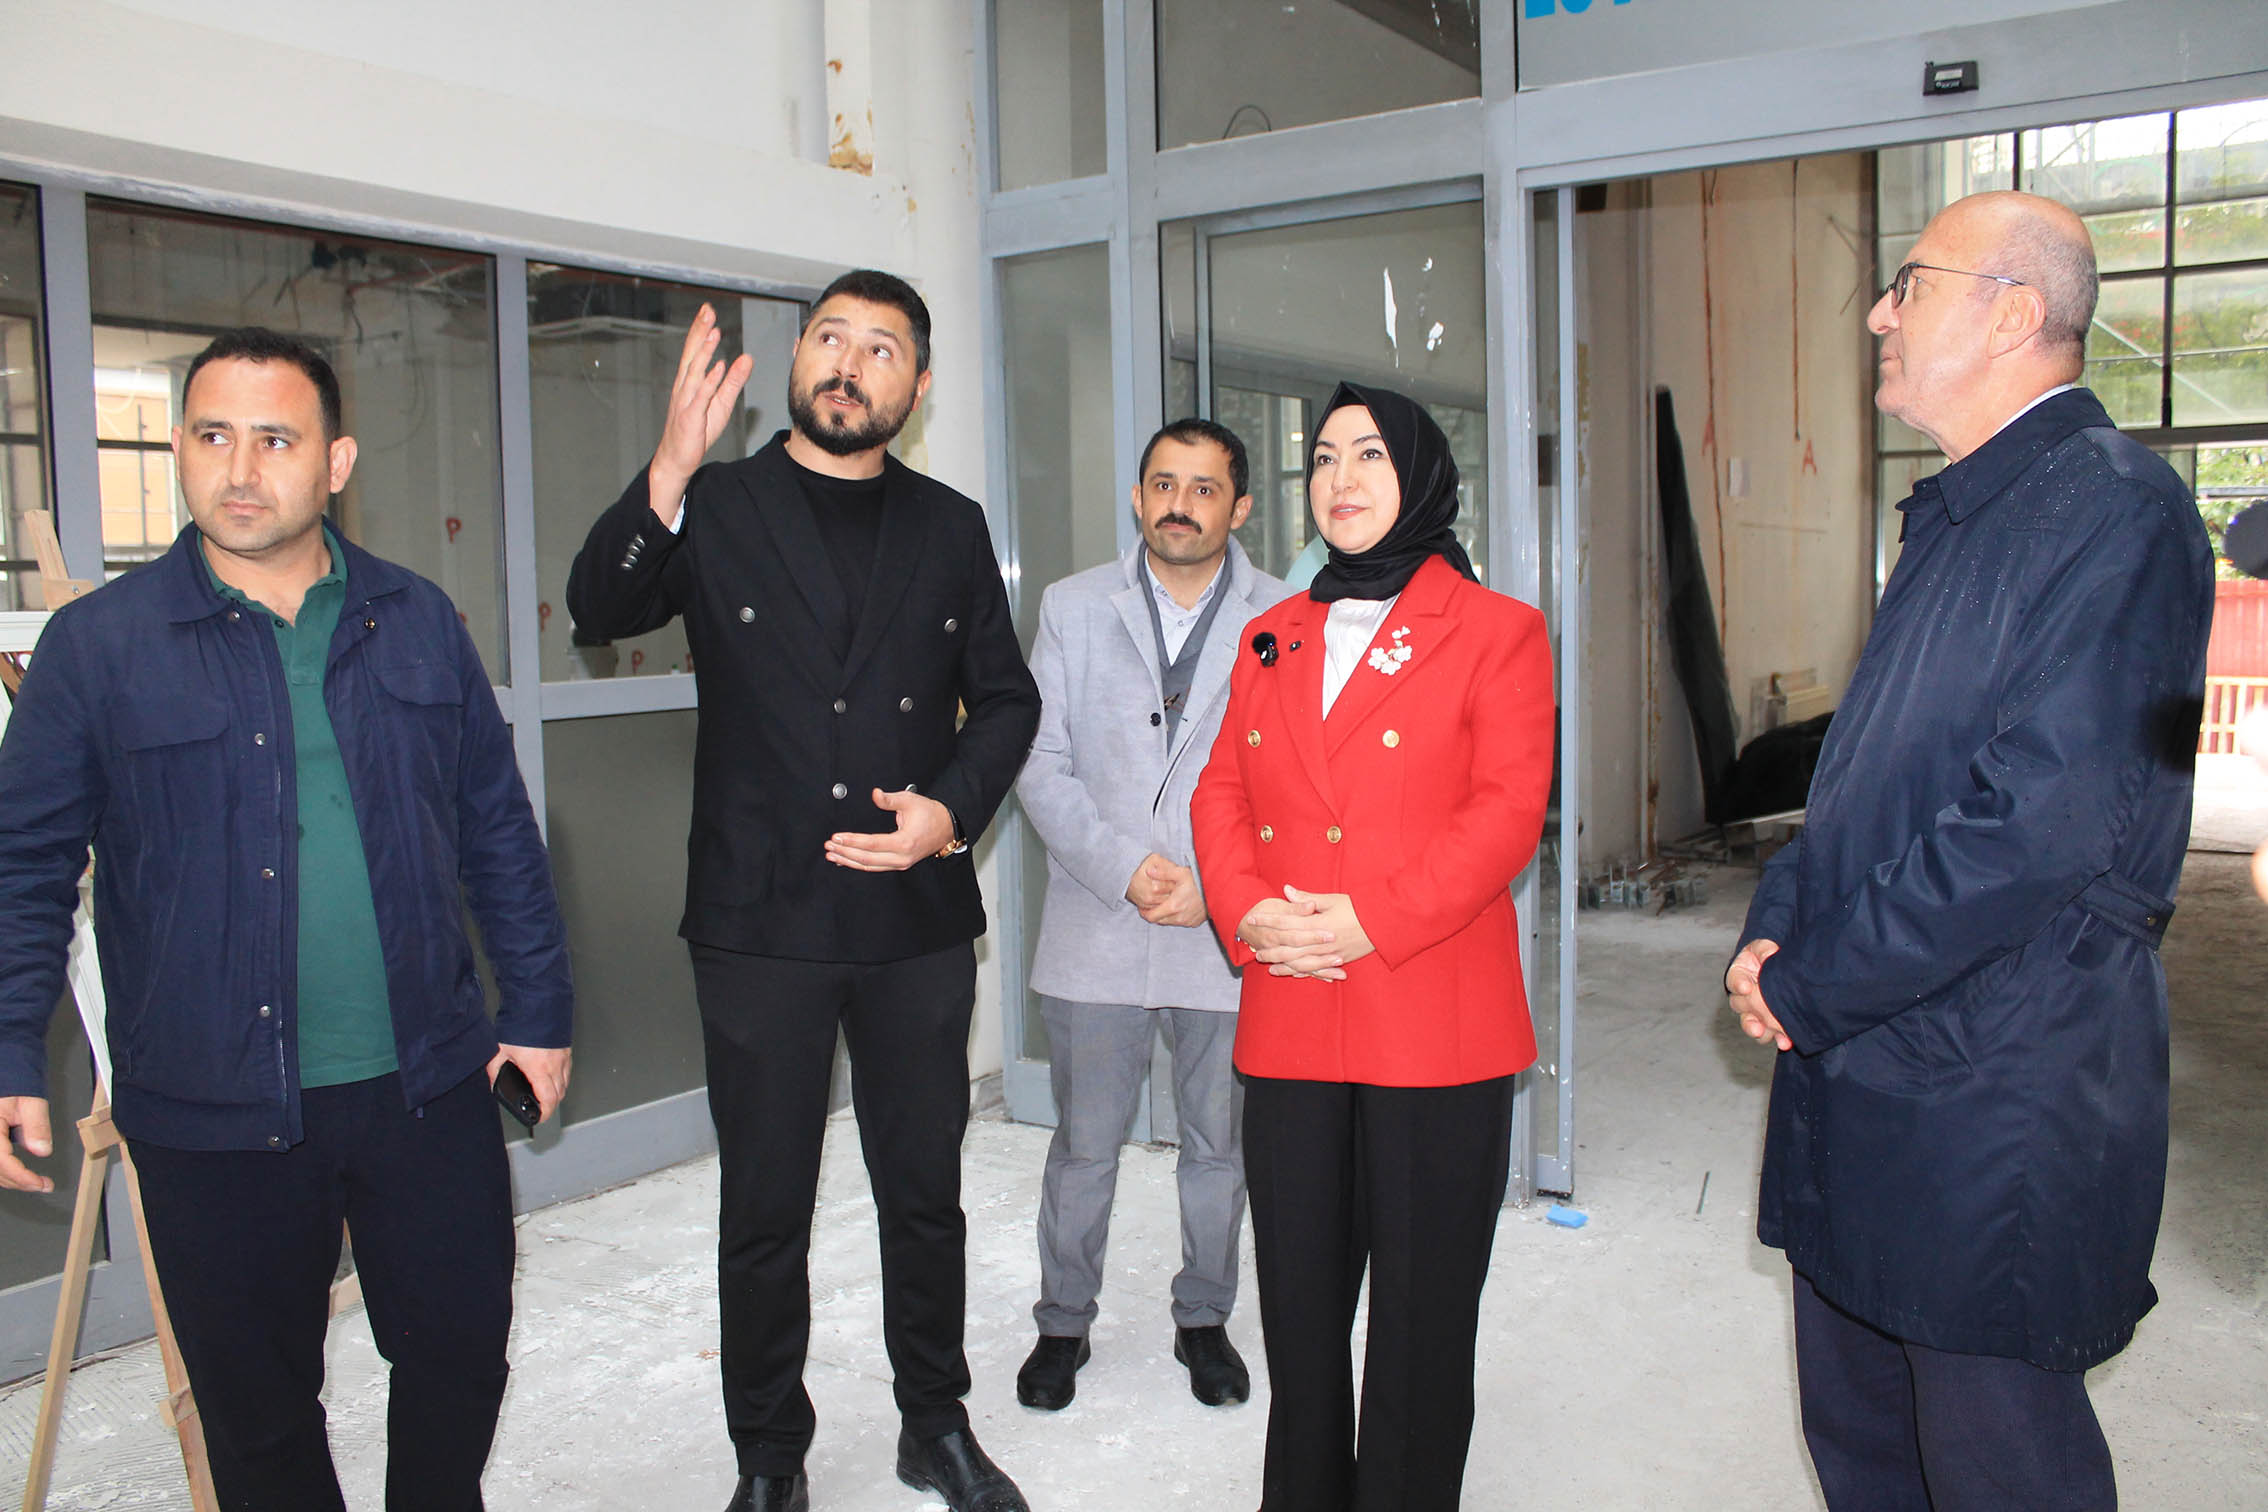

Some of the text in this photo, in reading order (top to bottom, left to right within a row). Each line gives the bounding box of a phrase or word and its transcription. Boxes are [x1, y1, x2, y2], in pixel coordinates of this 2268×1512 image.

[1802, 438, 1817, 475] A
[445, 516, 462, 544] P
[538, 602, 552, 632] P
